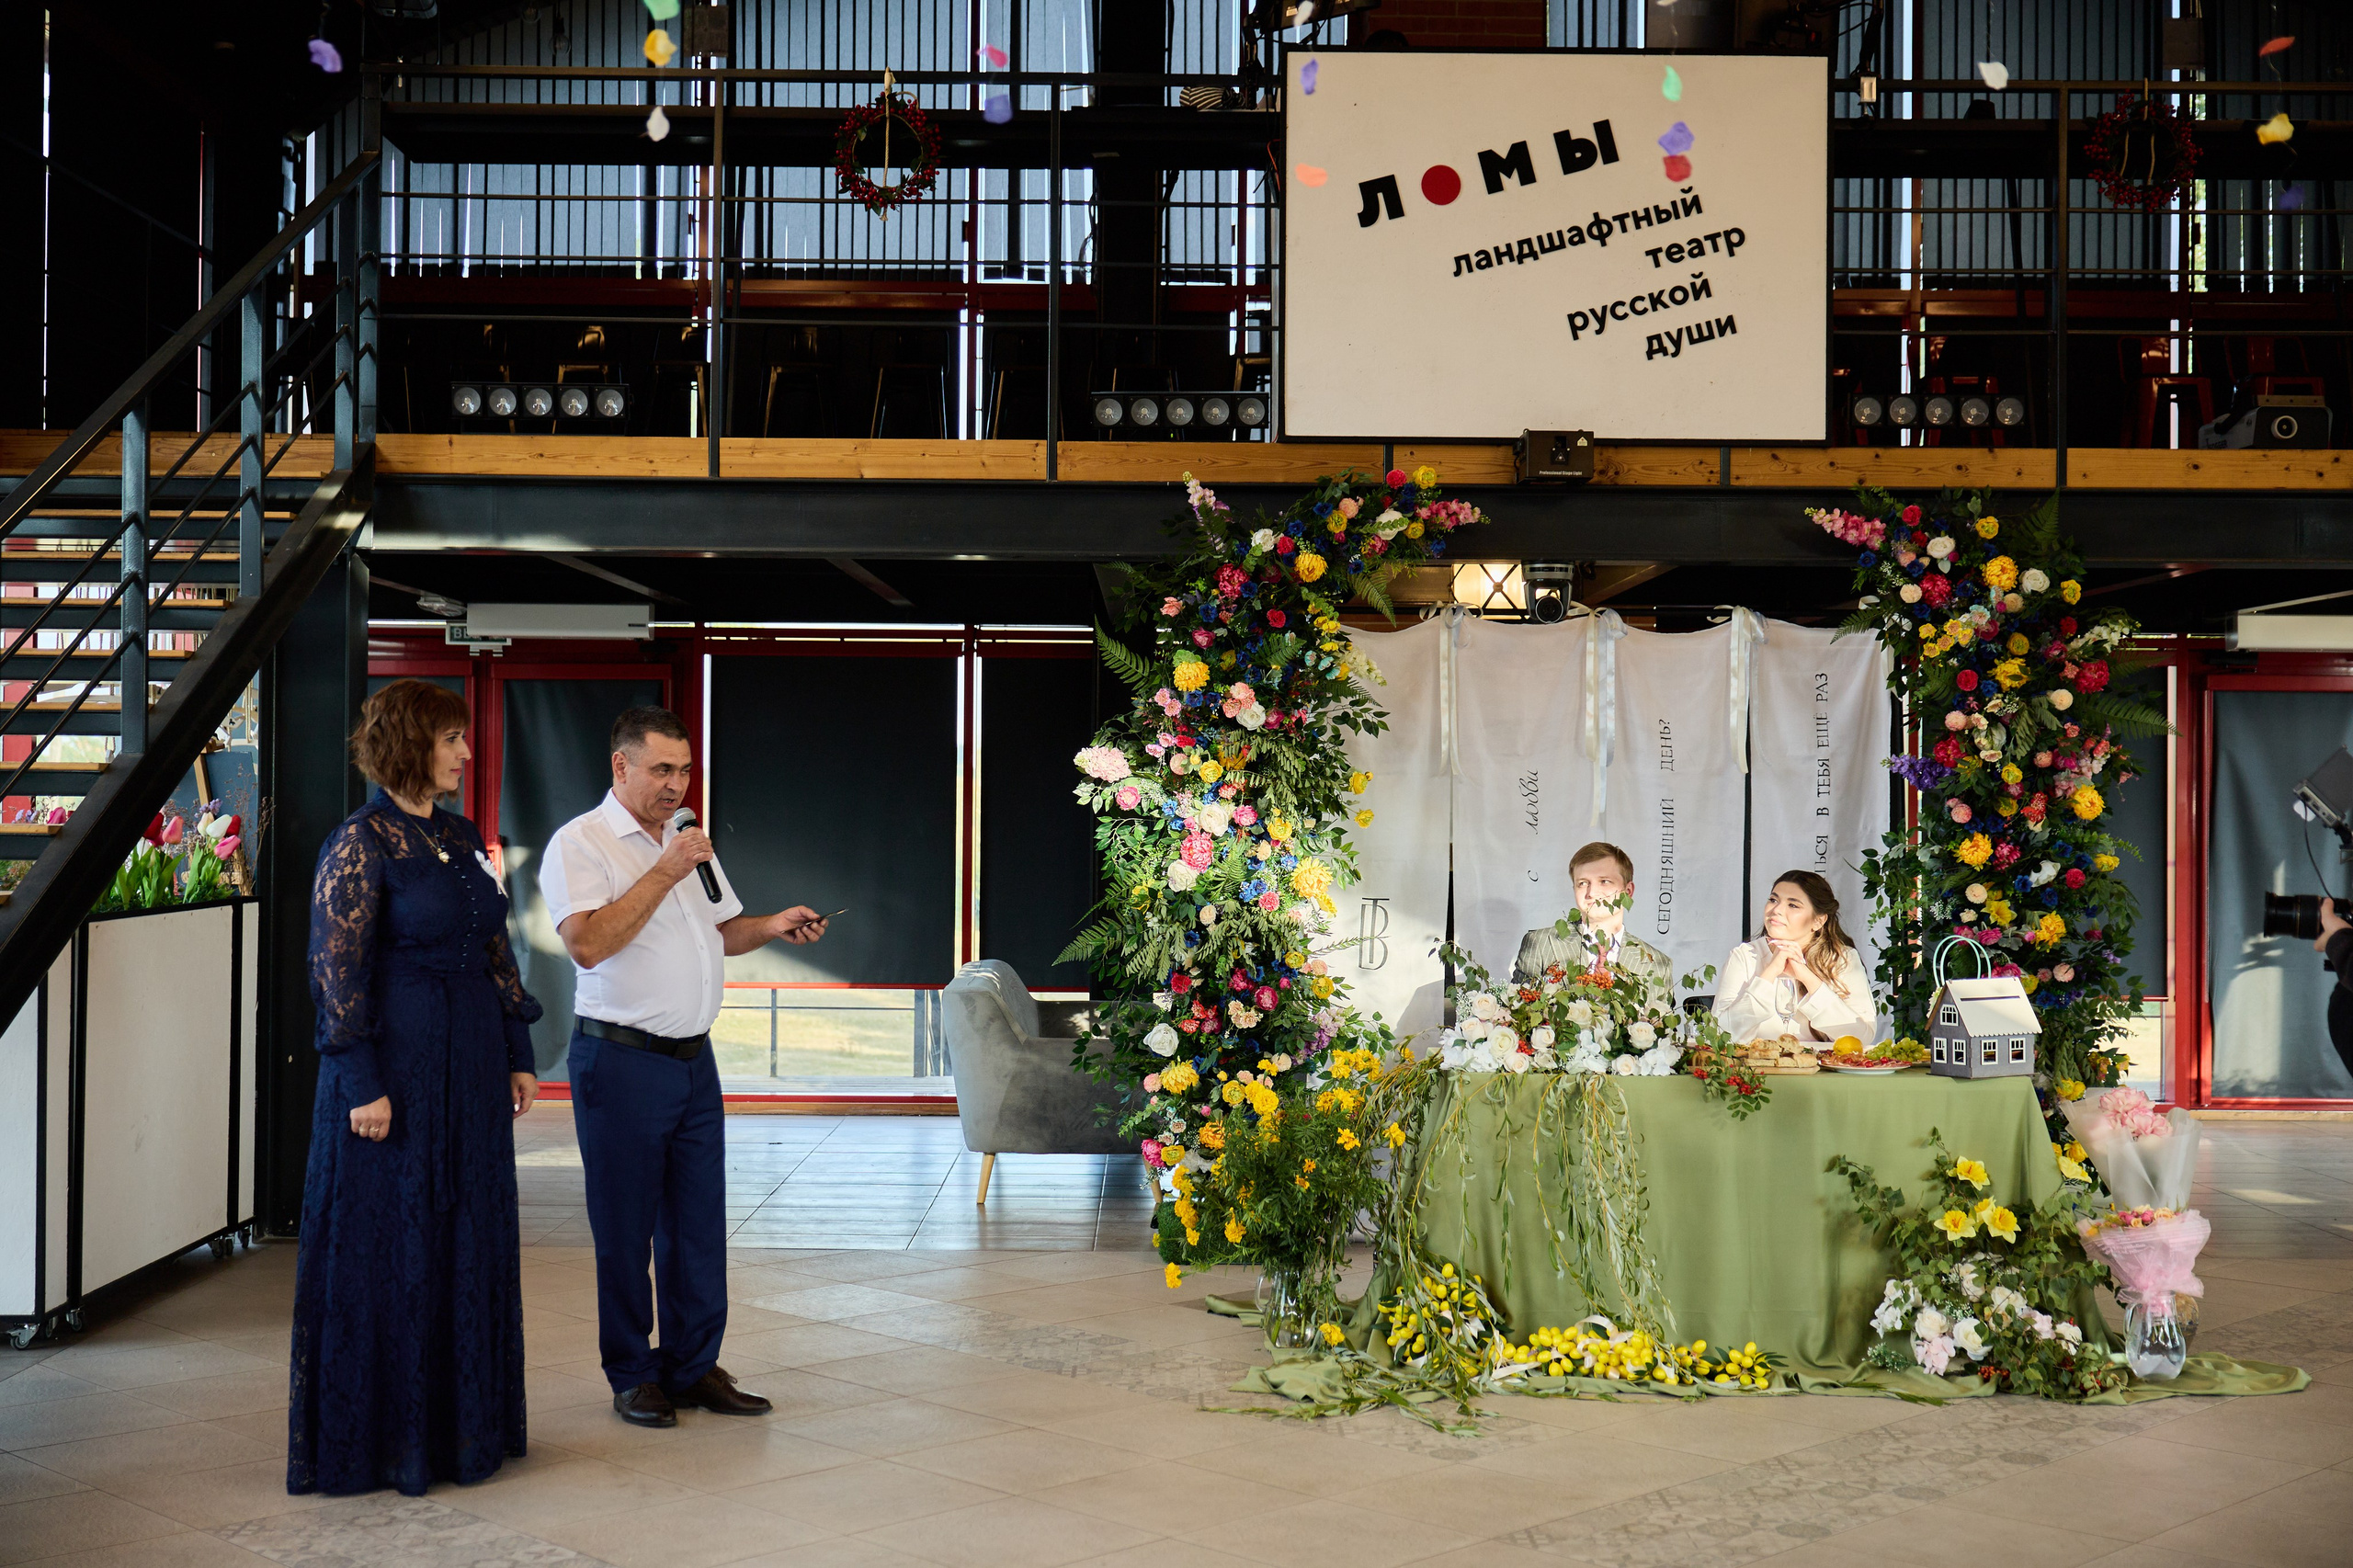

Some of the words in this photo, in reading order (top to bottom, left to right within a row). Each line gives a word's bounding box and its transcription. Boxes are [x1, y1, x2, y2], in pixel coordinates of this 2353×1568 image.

[1452, 186, 1703, 277] ландшафтный
[1644, 226, 1746, 268] театр
[1566, 271, 1712, 341] русской
[1644, 314, 1738, 360] души
[1814, 672, 1829, 703] РАЗ
[1658, 718, 1676, 772] ДЕНЬ?
[1813, 712, 1830, 748] ЕЩЁ
[1816, 757, 1831, 798] ТЕБЯ
[1518, 768, 1540, 835] любви
[1815, 806, 1830, 817] В
[1657, 798, 1676, 936] СЕГОДНЯШНИЙ
